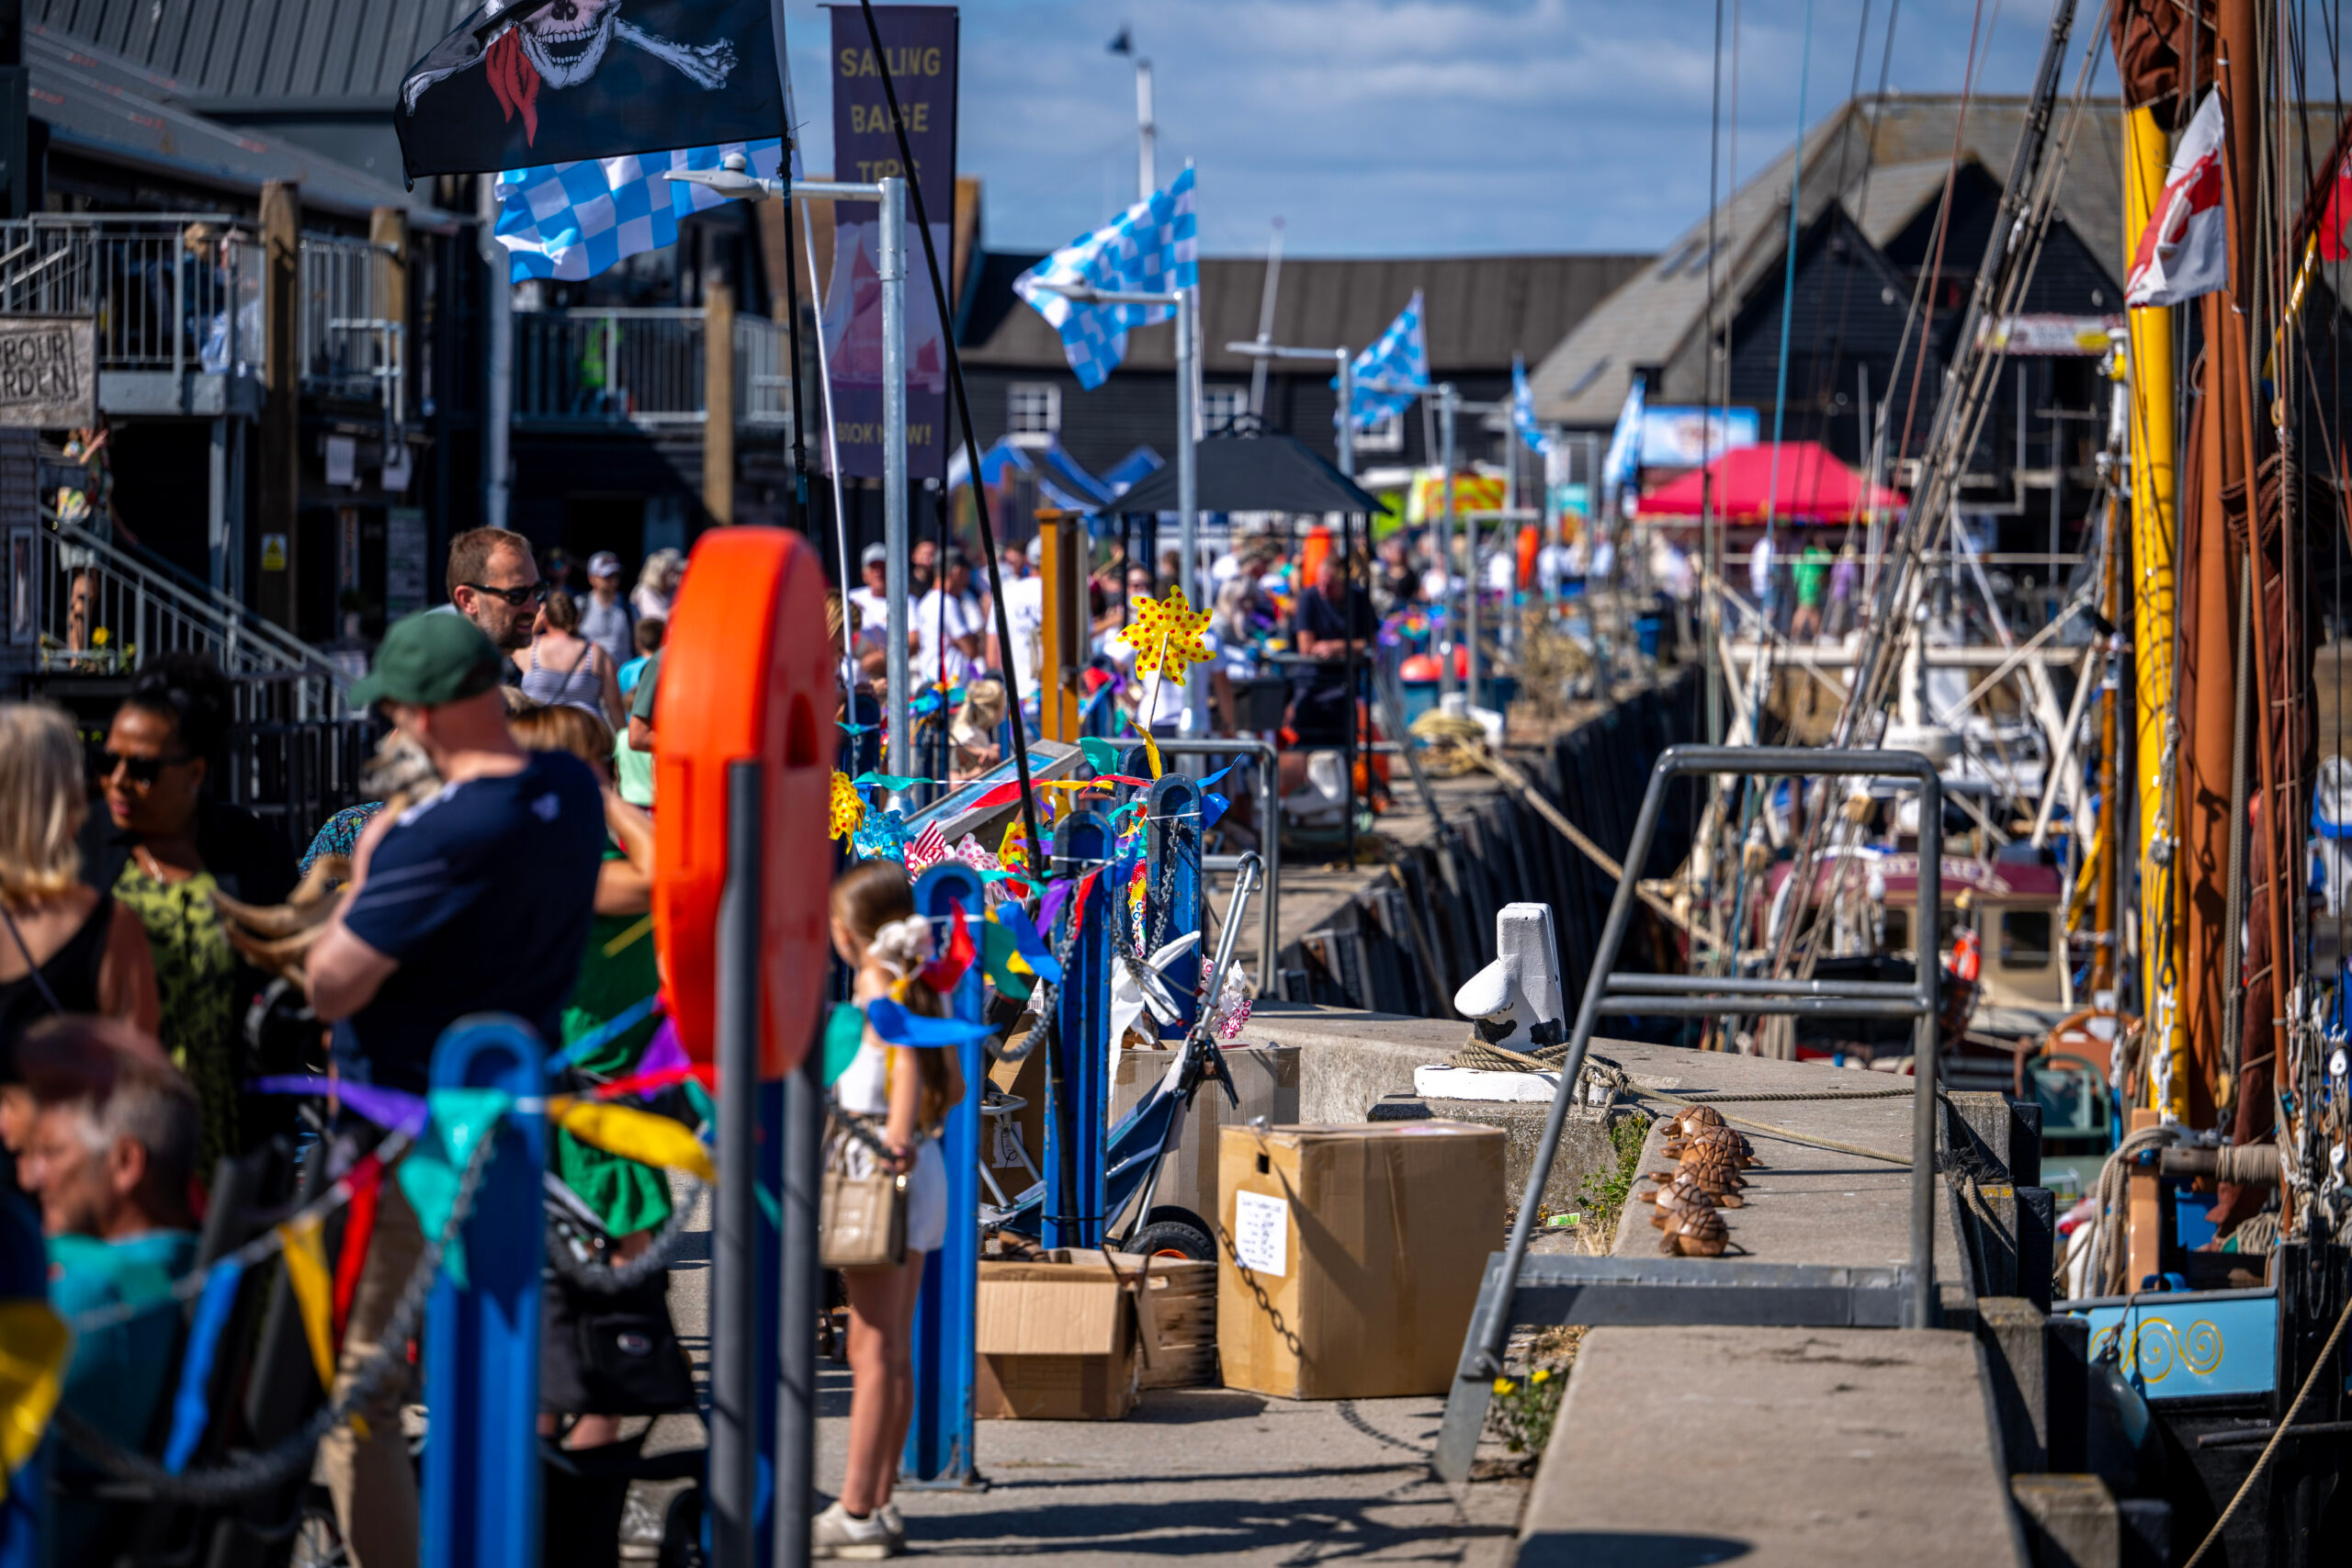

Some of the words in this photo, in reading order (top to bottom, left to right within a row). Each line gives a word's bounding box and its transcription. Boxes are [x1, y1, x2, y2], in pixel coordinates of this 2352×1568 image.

[840, 47, 942, 77] SALING
[856, 159, 922, 188] TPS
[0, 333, 66, 367] BOUR
[876, 423, 932, 446] NW!
